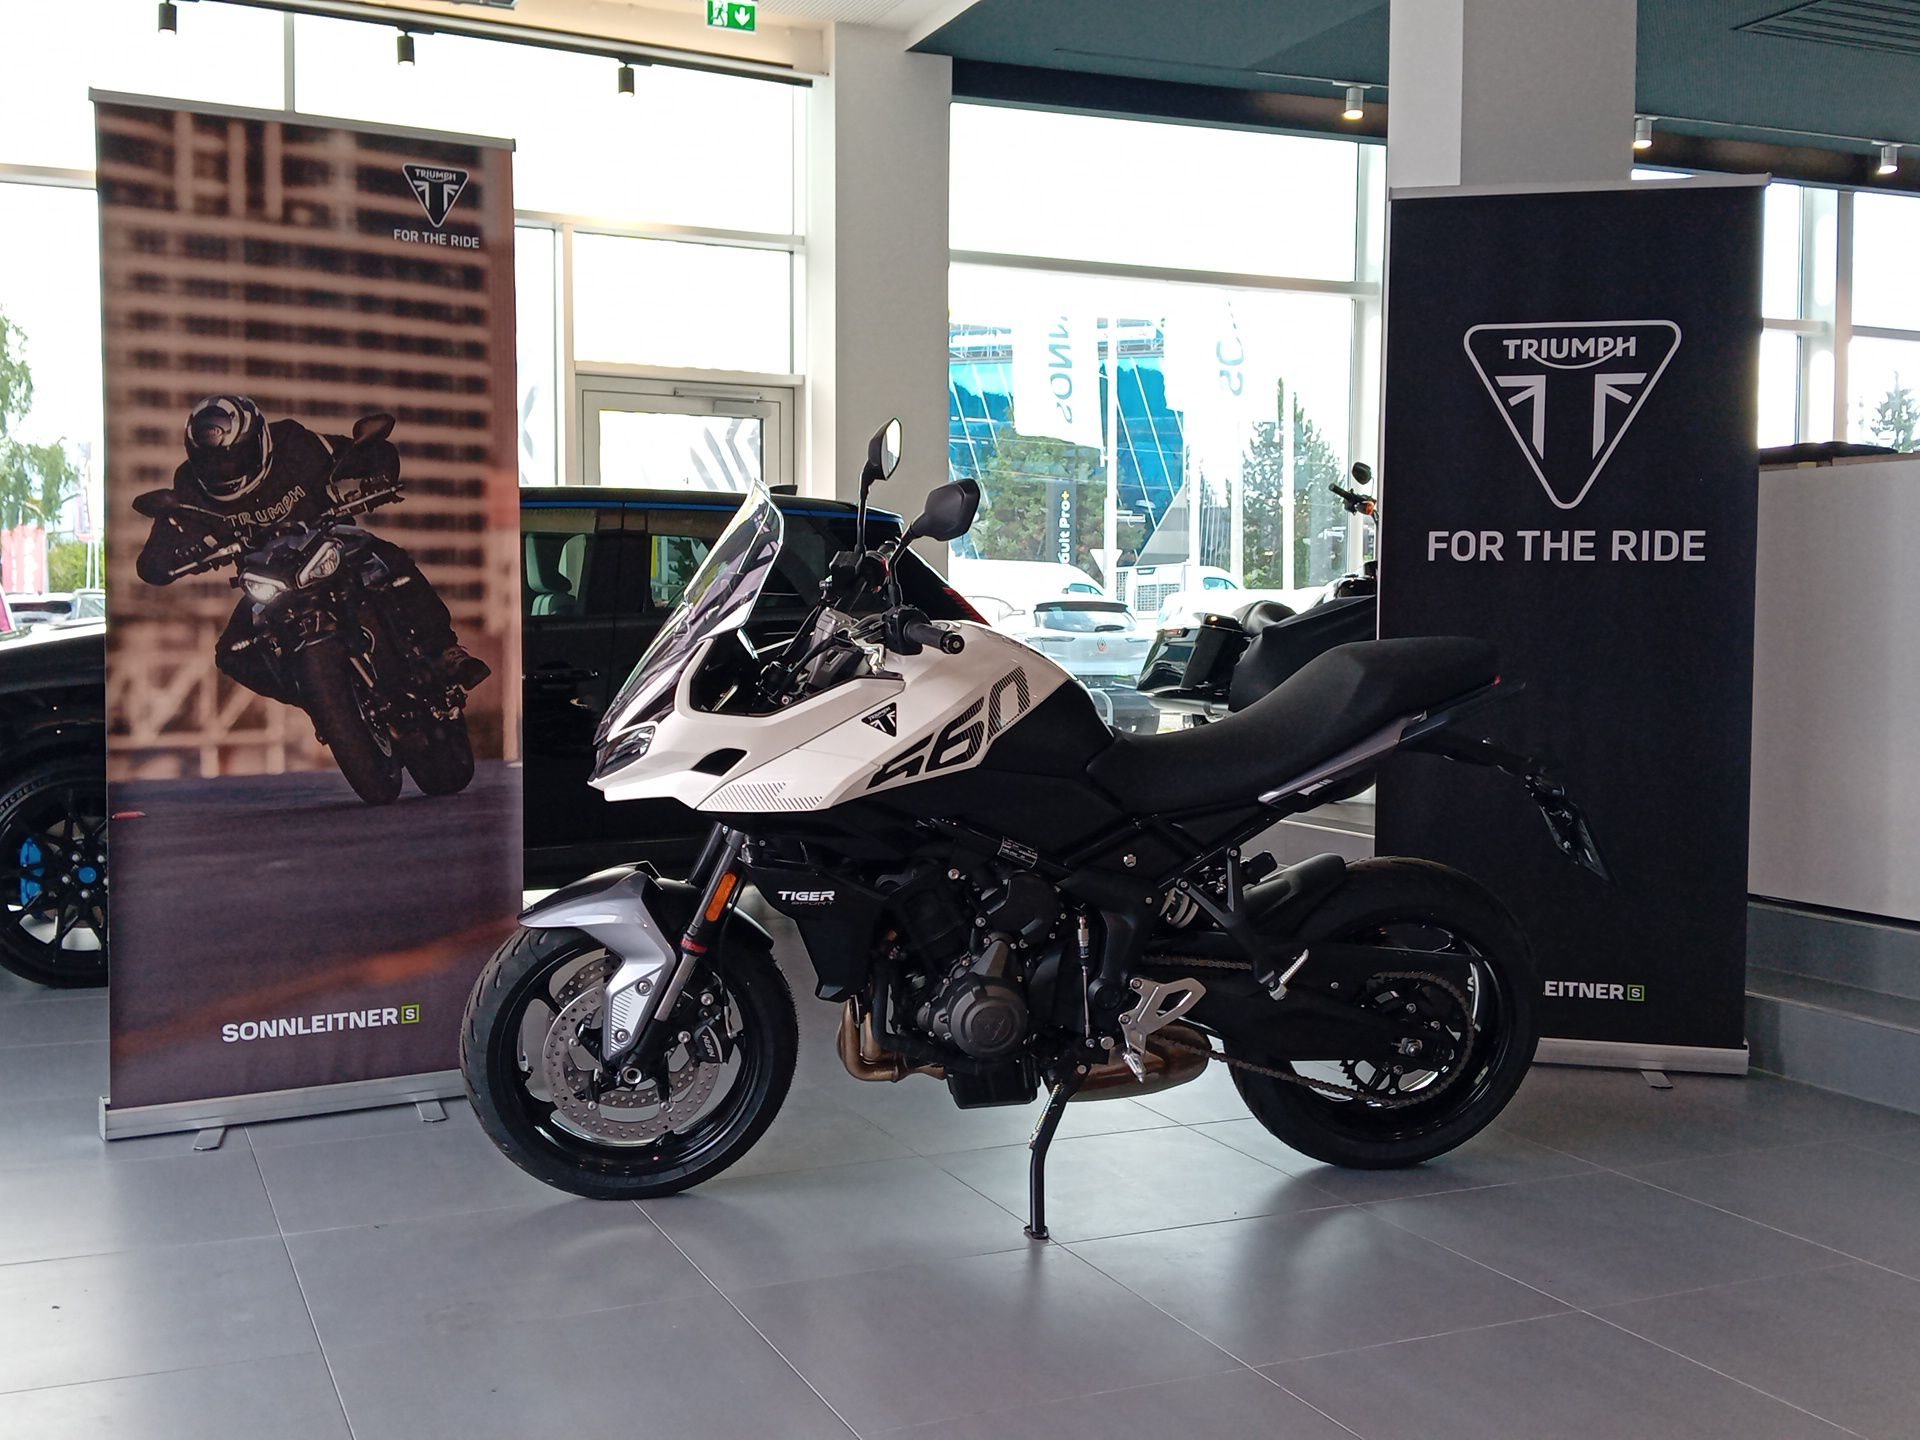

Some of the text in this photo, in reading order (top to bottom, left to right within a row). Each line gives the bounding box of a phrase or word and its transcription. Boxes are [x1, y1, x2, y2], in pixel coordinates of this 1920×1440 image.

[414, 168, 457, 182] TRIUMPH
[393, 228, 480, 249] FOR THE RIDE
[1502, 336, 1637, 369] TRIUMPH
[226, 485, 306, 528] TRUMPH
[1058, 530, 1070, 564] ault
[1427, 530, 1706, 562] FOR THE RIDE
[777, 890, 836, 901] TIGER
[1542, 980, 1625, 1000] EITNER
[221, 1007, 399, 1043] SONNLEITNER
